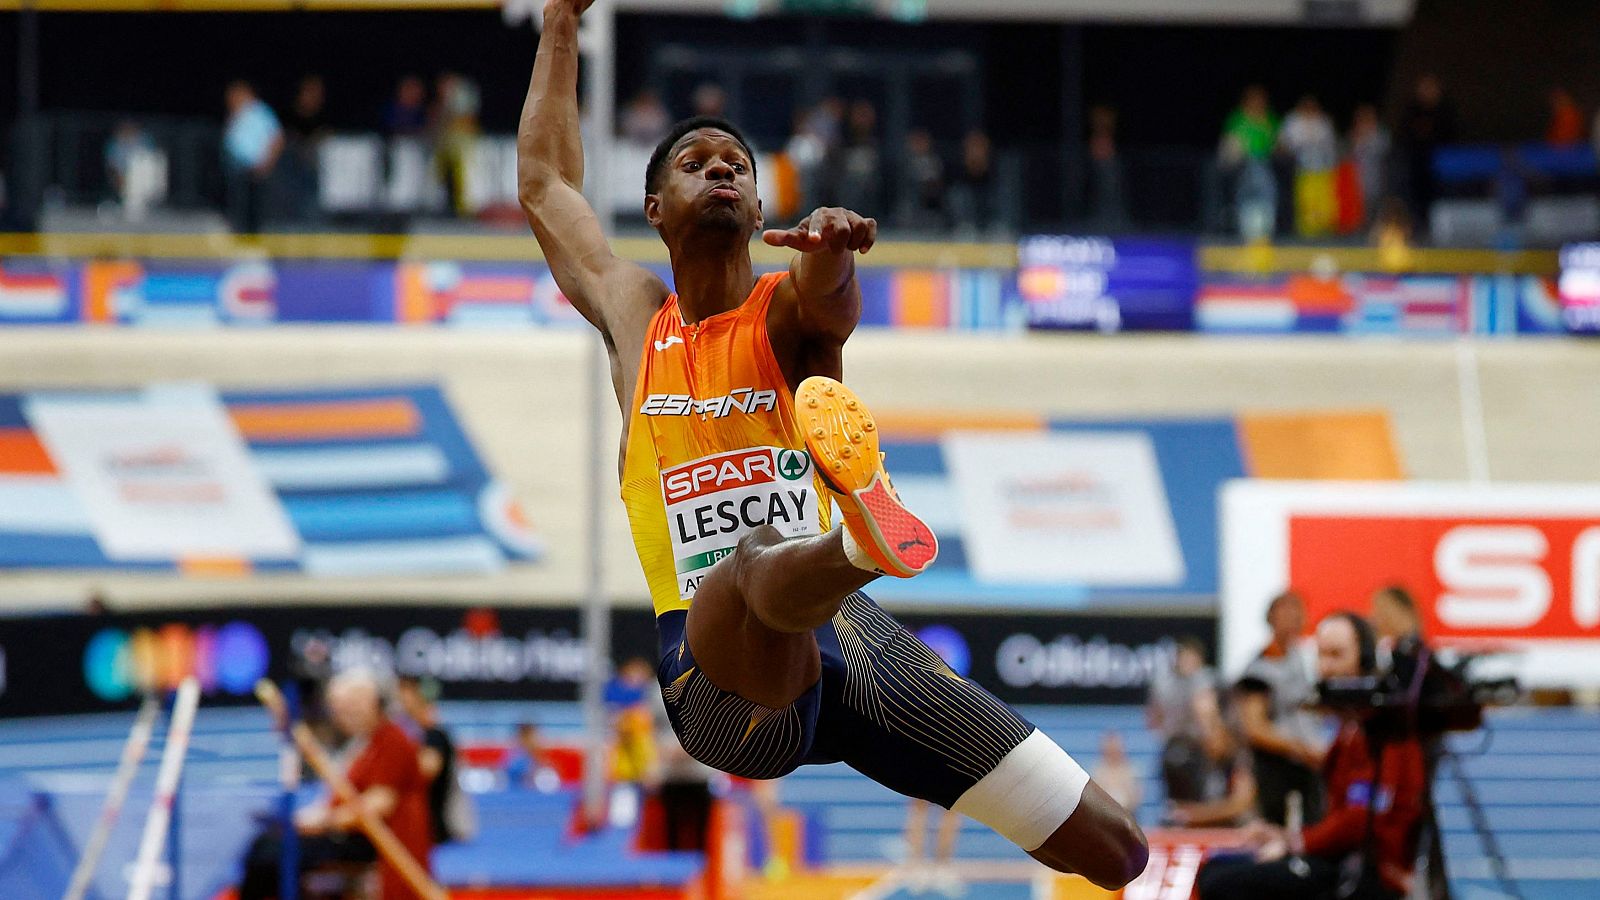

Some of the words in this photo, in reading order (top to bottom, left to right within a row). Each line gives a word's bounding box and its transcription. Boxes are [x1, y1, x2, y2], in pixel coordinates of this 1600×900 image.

[640, 387, 776, 419] ESPAÑA
[668, 456, 774, 498] SPAR
[676, 490, 806, 543] LESCAY
[1434, 524, 1600, 629] S
